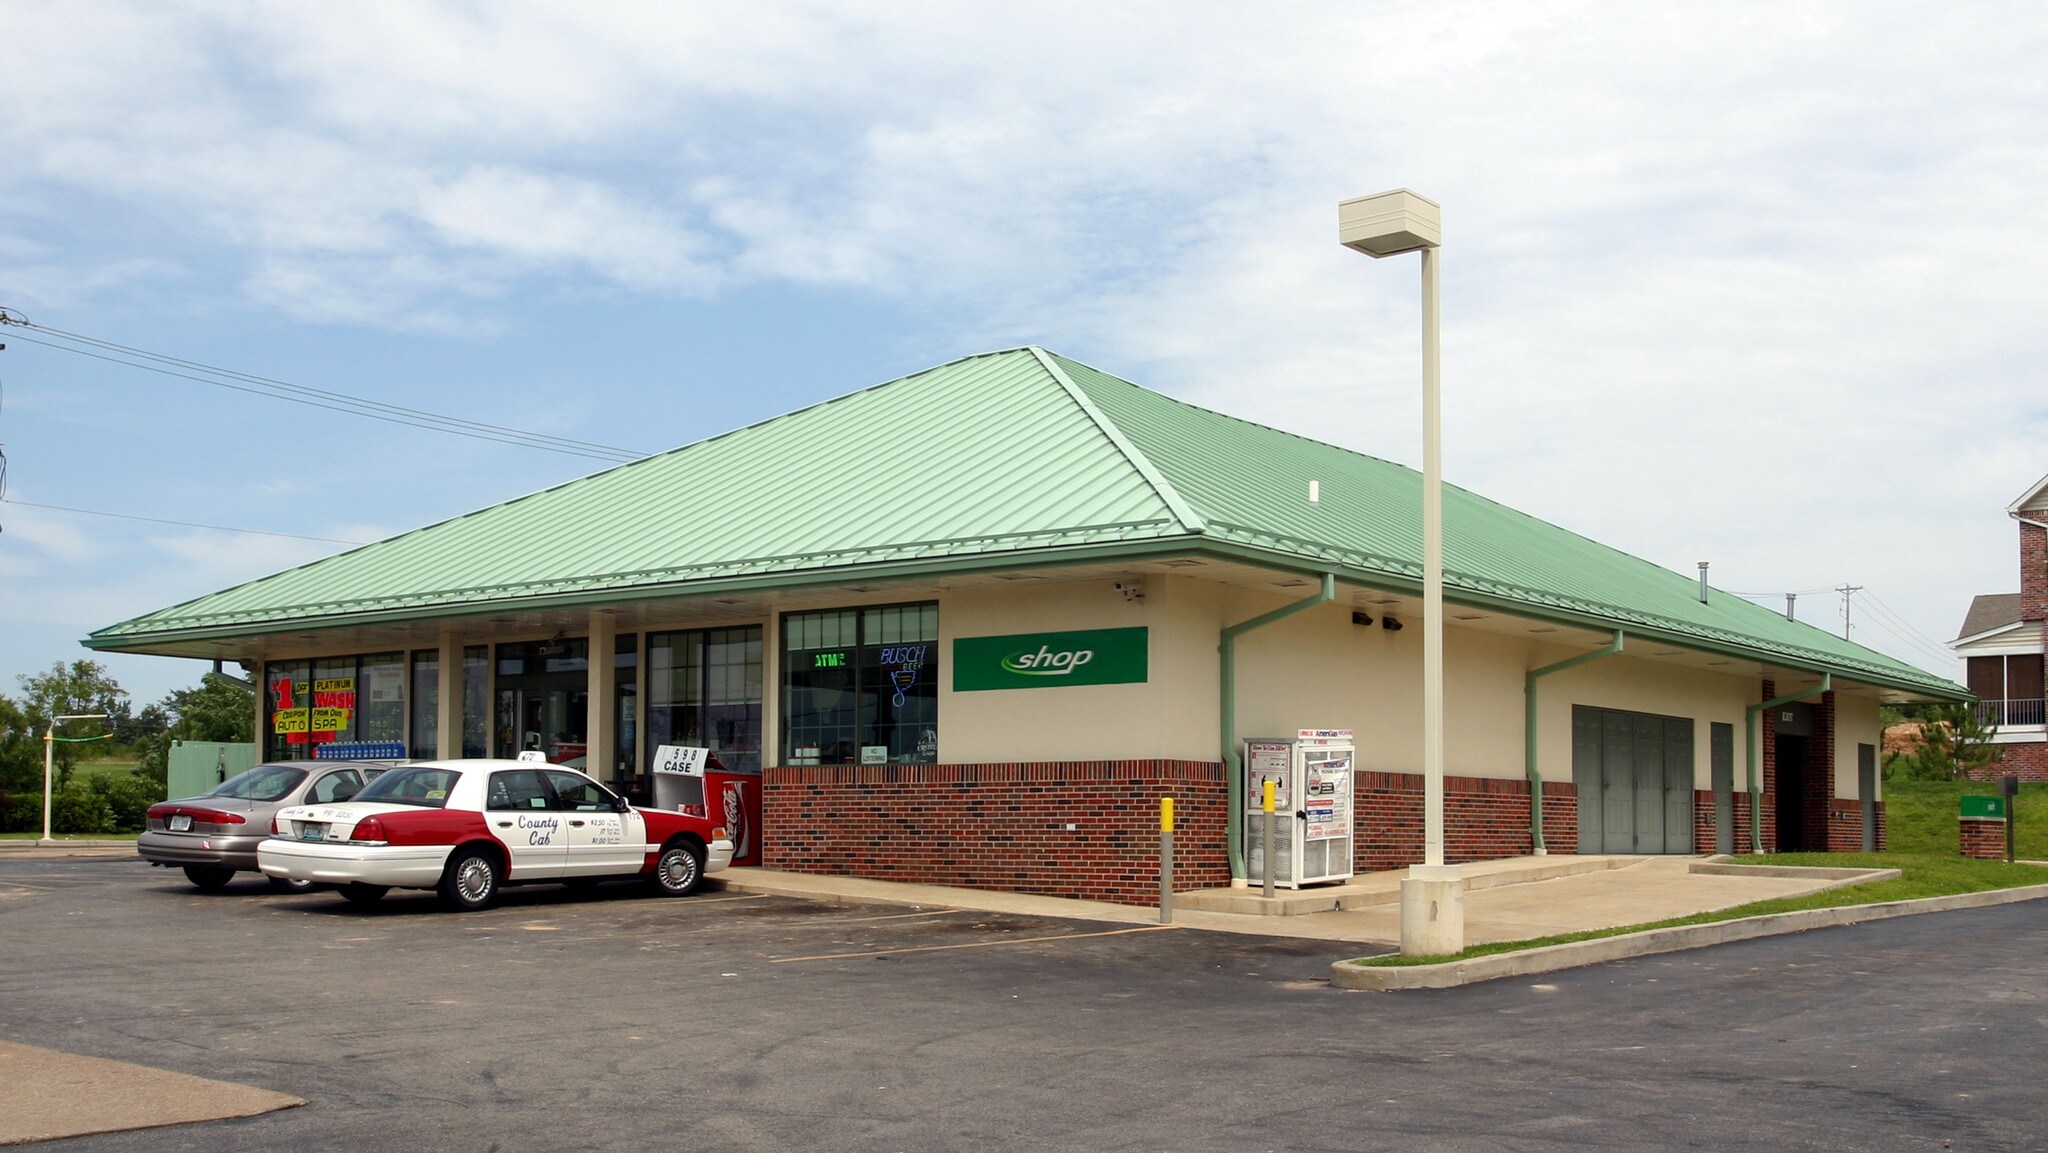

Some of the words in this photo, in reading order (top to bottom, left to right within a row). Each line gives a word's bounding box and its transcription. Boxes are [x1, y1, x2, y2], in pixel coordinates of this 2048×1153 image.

[881, 646, 926, 664] BUSCH
[1013, 645, 1094, 674] shop
[297, 683, 309, 693] OFF
[316, 680, 351, 690] PLATINUM
[315, 691, 355, 710] WASH
[278, 721, 305, 730] AUTO
[314, 719, 337, 729] SPA
[664, 761, 691, 772] CASE
[518, 815, 558, 834] County
[529, 831, 551, 845] Cab
